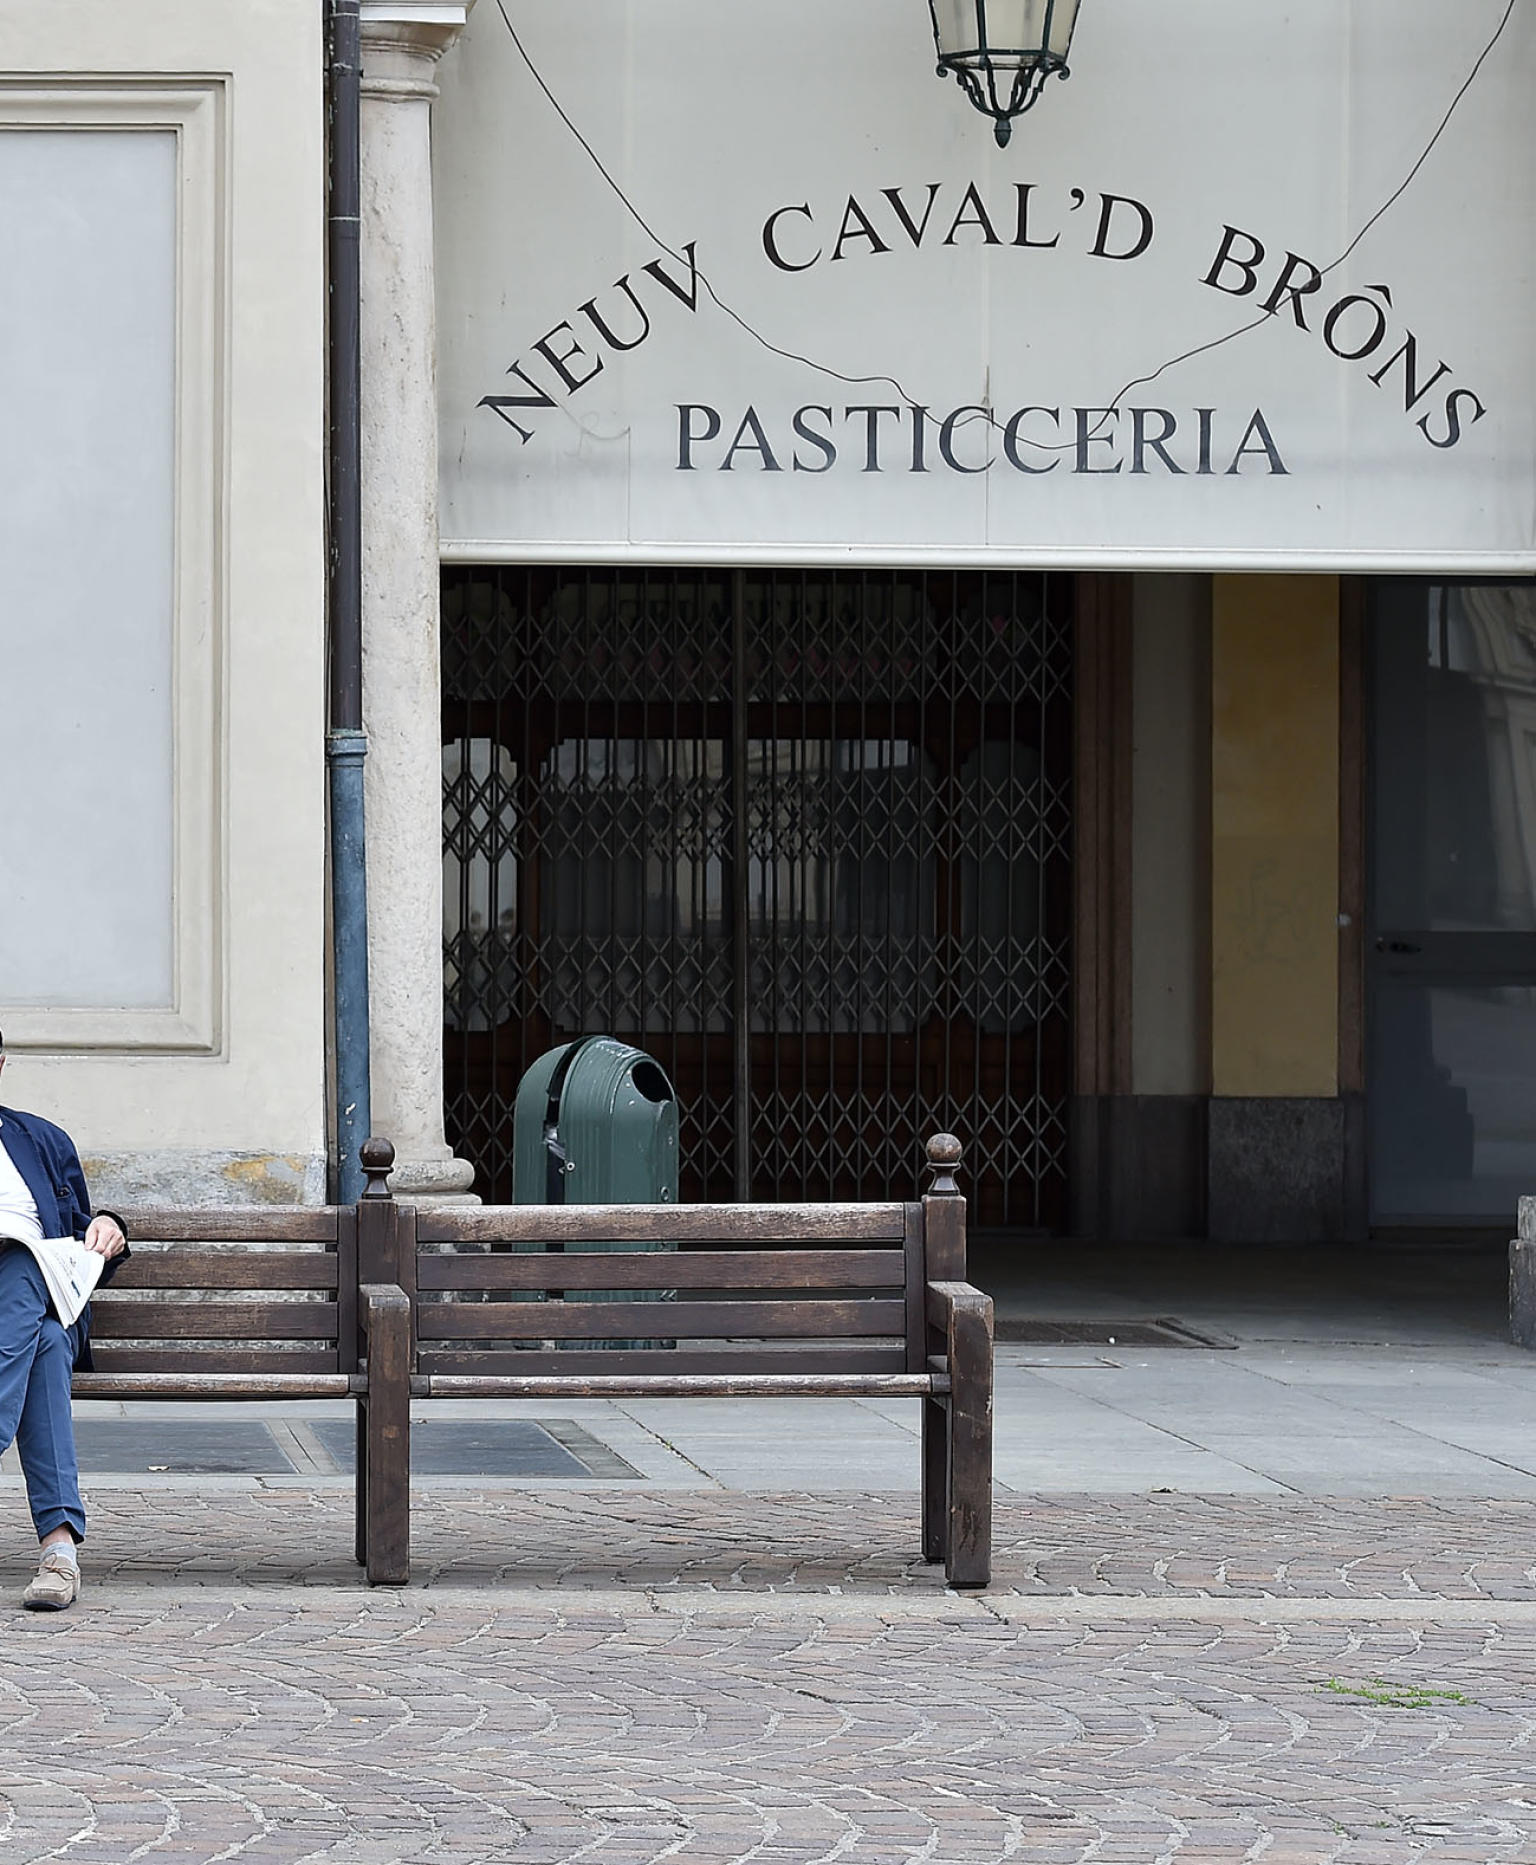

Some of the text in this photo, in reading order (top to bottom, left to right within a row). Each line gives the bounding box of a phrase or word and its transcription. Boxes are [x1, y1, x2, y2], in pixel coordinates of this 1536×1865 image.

[475, 240, 700, 446] NEUV
[1198, 224, 1487, 449] BRÔNS
[674, 404, 1291, 475] PASTICCERIA
